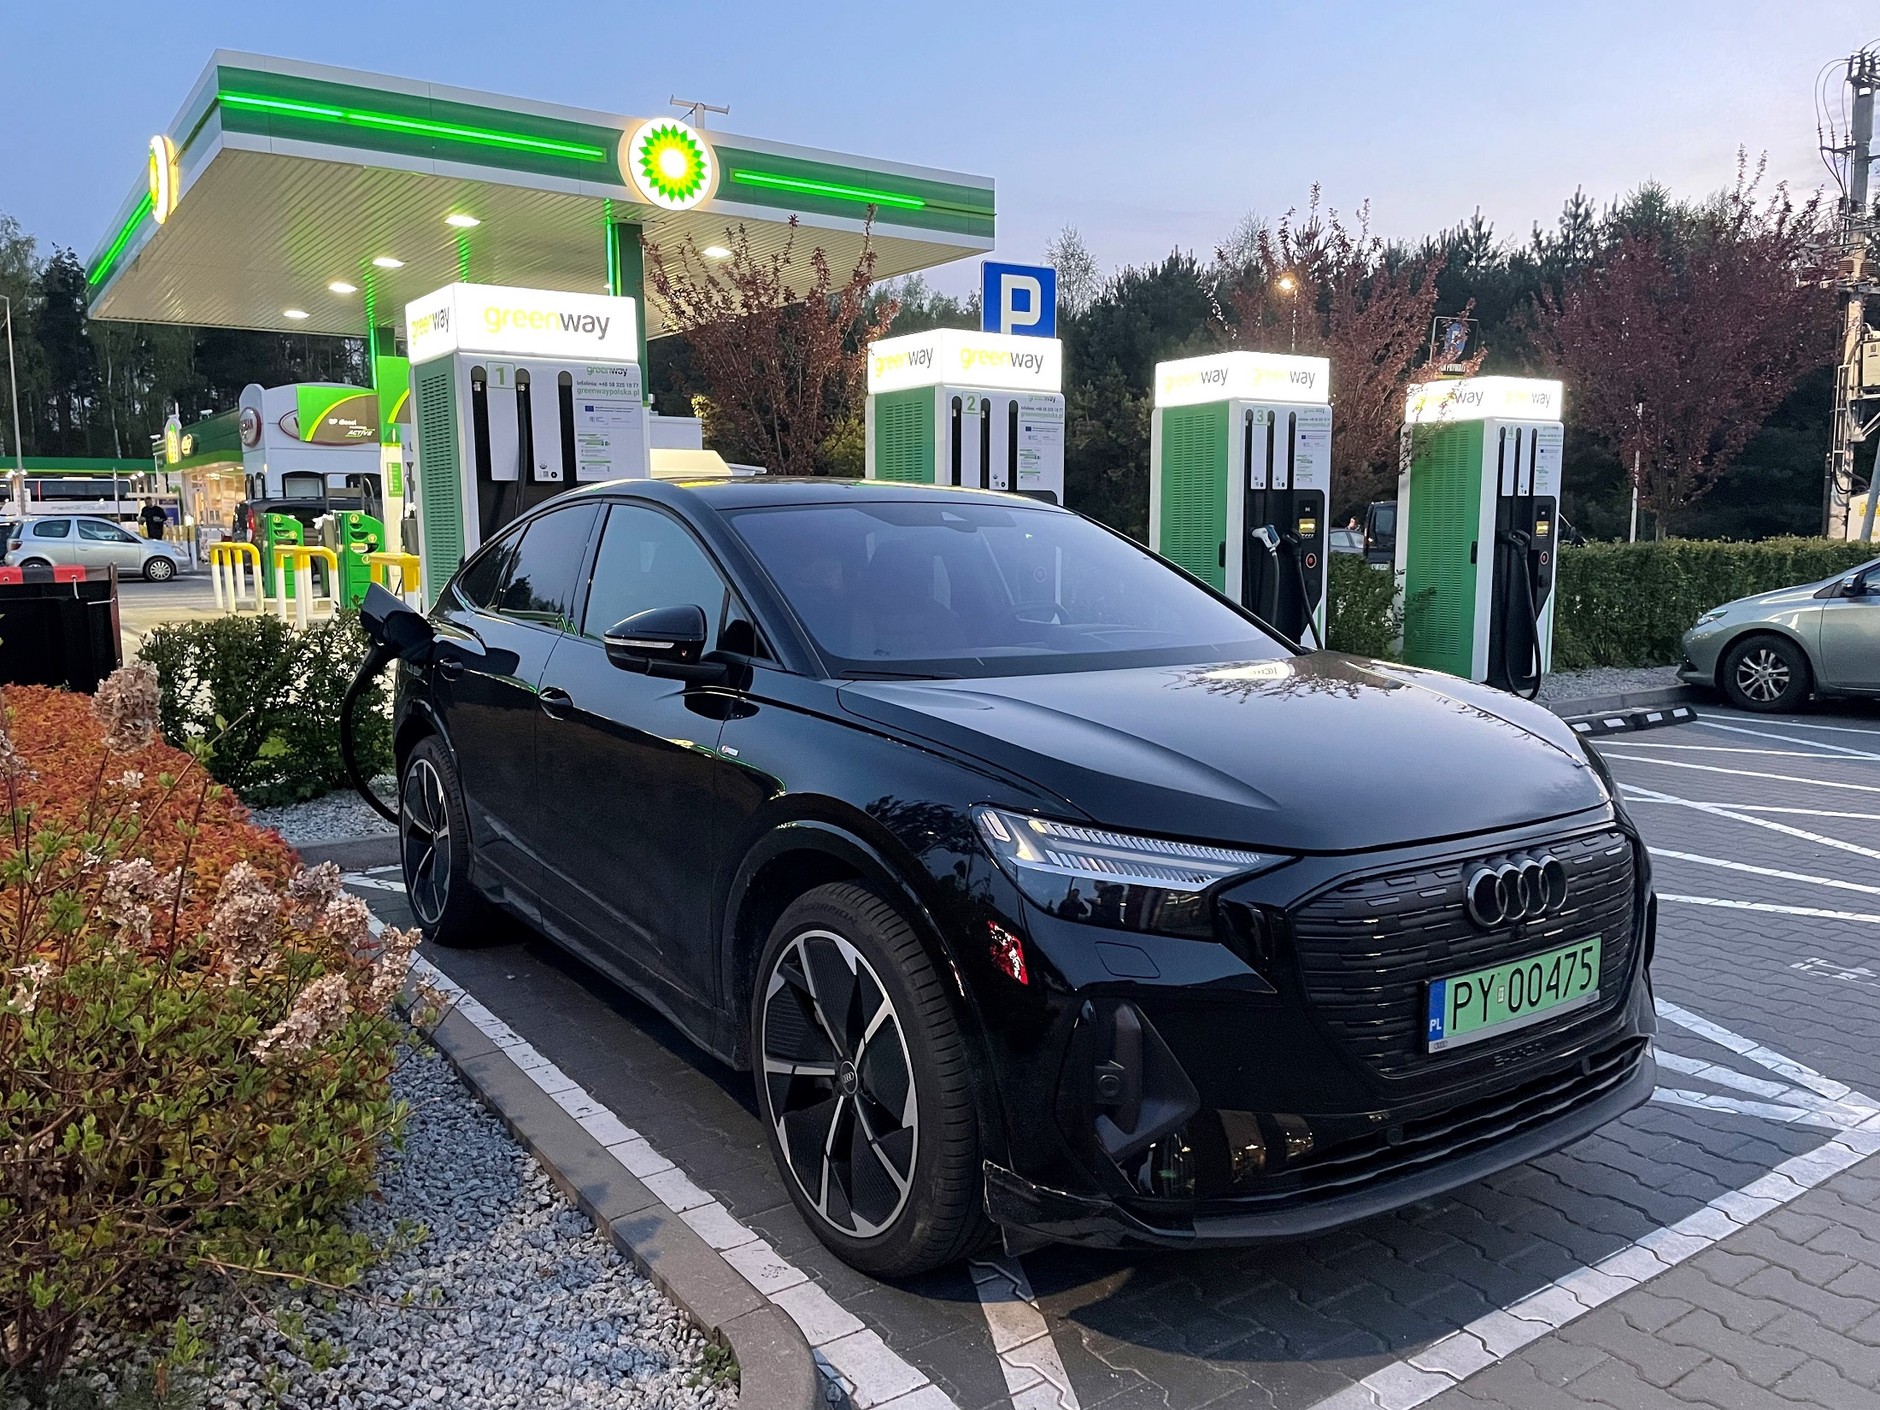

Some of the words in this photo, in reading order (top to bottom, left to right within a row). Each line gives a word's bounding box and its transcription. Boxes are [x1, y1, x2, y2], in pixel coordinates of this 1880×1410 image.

[1001, 274, 1041, 335] P
[411, 306, 450, 346] greenway
[483, 306, 610, 340] greenway
[875, 347, 934, 378] greenway
[959, 347, 1044, 374] greenway
[495, 366, 505, 386] 1
[586, 366, 628, 377] greenway
[577, 387, 640, 397] greenwaypolska.pl
[966, 395, 976, 411] 2
[1257, 409, 1264, 423] 3
[1508, 425, 1515, 437] 4
[1452, 973, 1496, 1031] PY
[1507, 945, 1594, 1014] 00475
[1429, 1018, 1442, 1033] PL
